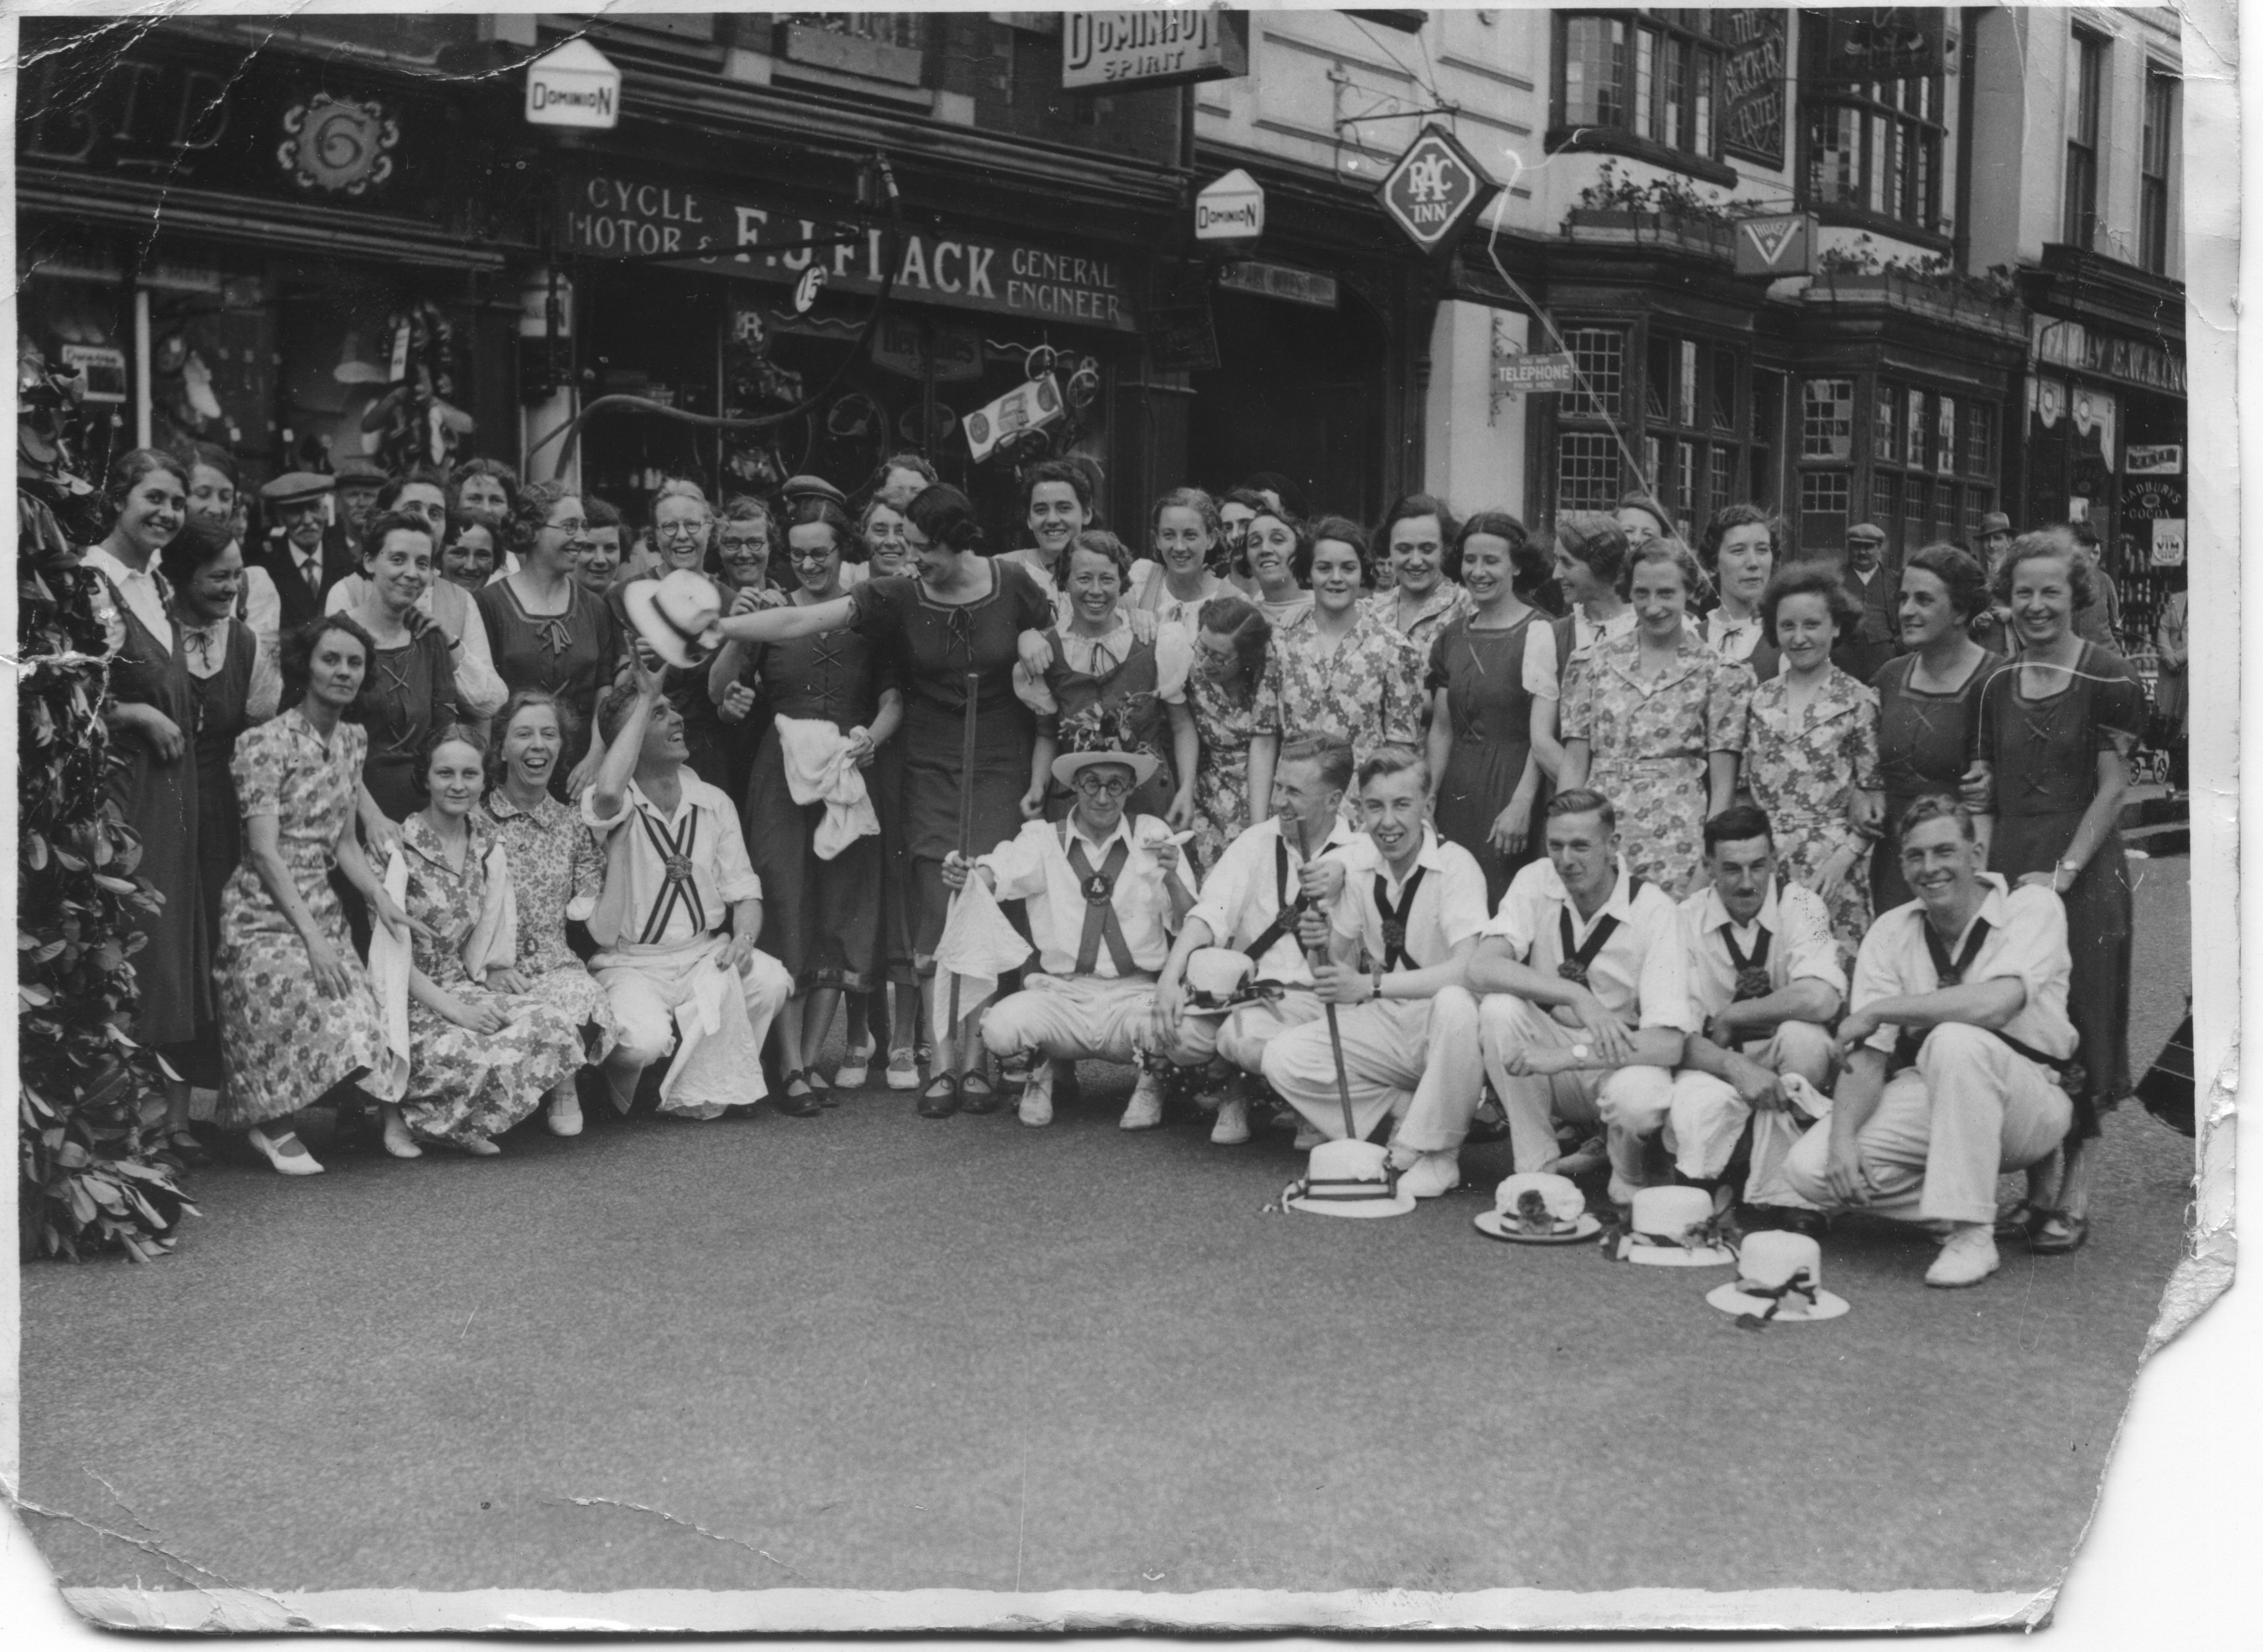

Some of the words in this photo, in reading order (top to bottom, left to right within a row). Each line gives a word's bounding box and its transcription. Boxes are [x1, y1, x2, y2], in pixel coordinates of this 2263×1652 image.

[1104, 50, 1185, 80] SPIRIT
[533, 82, 612, 115] DOMINION
[1408, 154, 1453, 202] RAC
[588, 177, 703, 224] CYCLE
[1199, 203, 1256, 229] DOMINION
[1410, 202, 1451, 223] INN
[569, 211, 682, 254] MOTOR
[1012, 249, 1116, 289] GENERAL
[1008, 280, 1121, 321] ENGINEER
[1499, 365, 1570, 382] TELEPHONE
